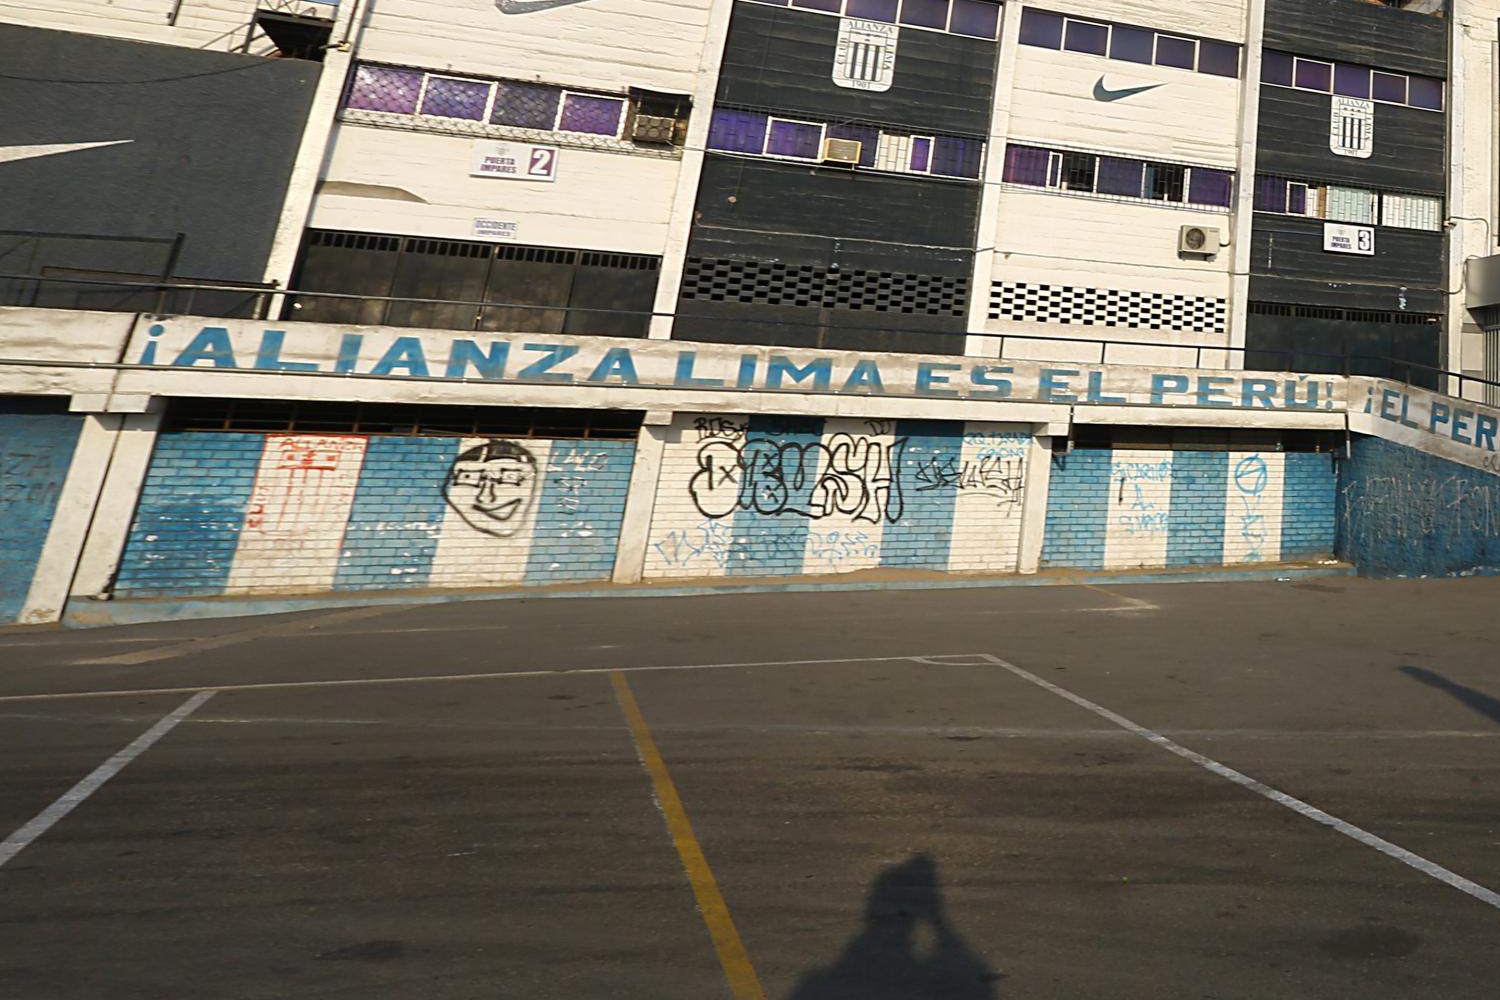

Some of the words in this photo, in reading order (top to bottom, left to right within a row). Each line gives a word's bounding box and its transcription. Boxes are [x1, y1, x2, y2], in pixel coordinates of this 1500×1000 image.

[848, 21, 893, 34] ALIANZA
[480, 164, 516, 173] IMPARES
[484, 156, 515, 165] PUERTA
[530, 150, 551, 174] 2
[1358, 230, 1371, 251] 3
[673, 351, 884, 394] LIMA
[914, 362, 1014, 399] ES
[1039, 368, 1127, 404] EL
[1150, 374, 1334, 410] PERÚ!
